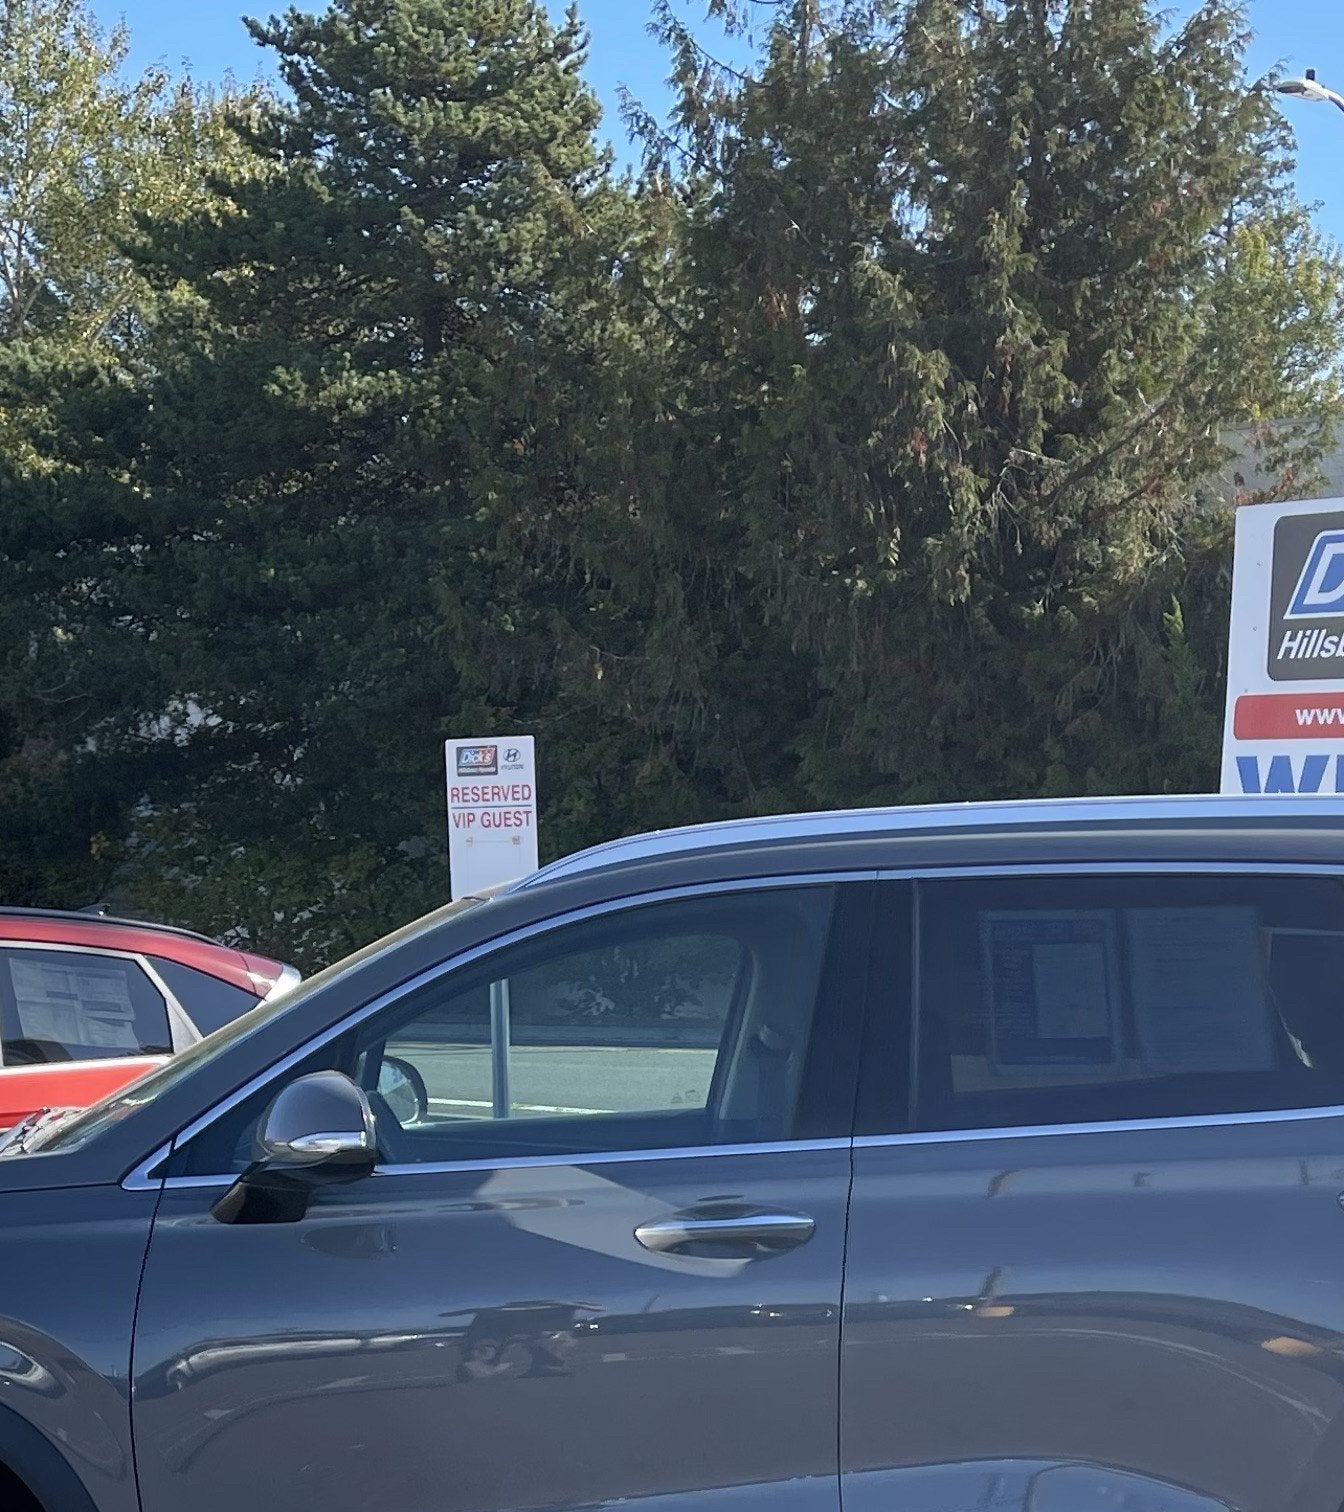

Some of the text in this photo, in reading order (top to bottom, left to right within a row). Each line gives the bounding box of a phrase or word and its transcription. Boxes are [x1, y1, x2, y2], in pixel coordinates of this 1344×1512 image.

[450, 784, 532, 803] RESERVED
[452, 810, 533, 829] VIP GUEST
